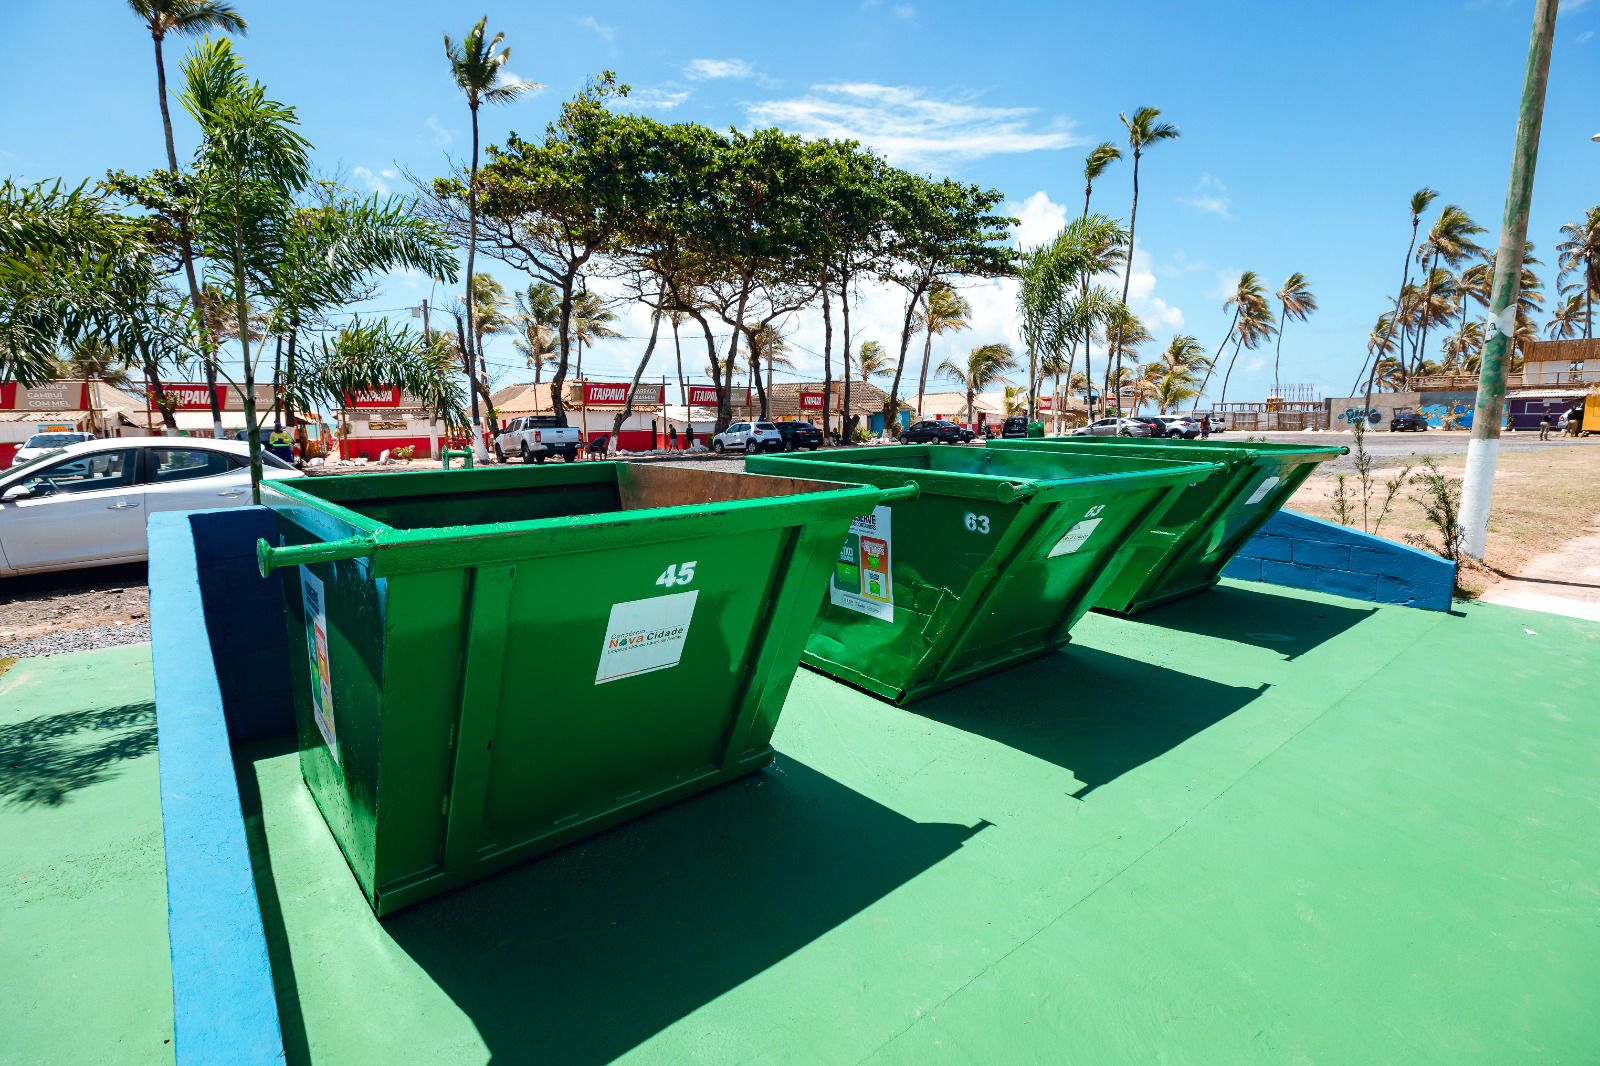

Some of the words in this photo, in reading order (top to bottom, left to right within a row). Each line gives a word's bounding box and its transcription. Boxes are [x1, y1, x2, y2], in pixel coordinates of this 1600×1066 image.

[589, 388, 625, 400] ITAIPAVA
[692, 390, 718, 402] ITAIPA
[1084, 504, 1106, 518] 63
[965, 512, 990, 534] 63
[655, 561, 698, 587] 45
[608, 634, 645, 649] Nova
[646, 627, 684, 641] Cidade
